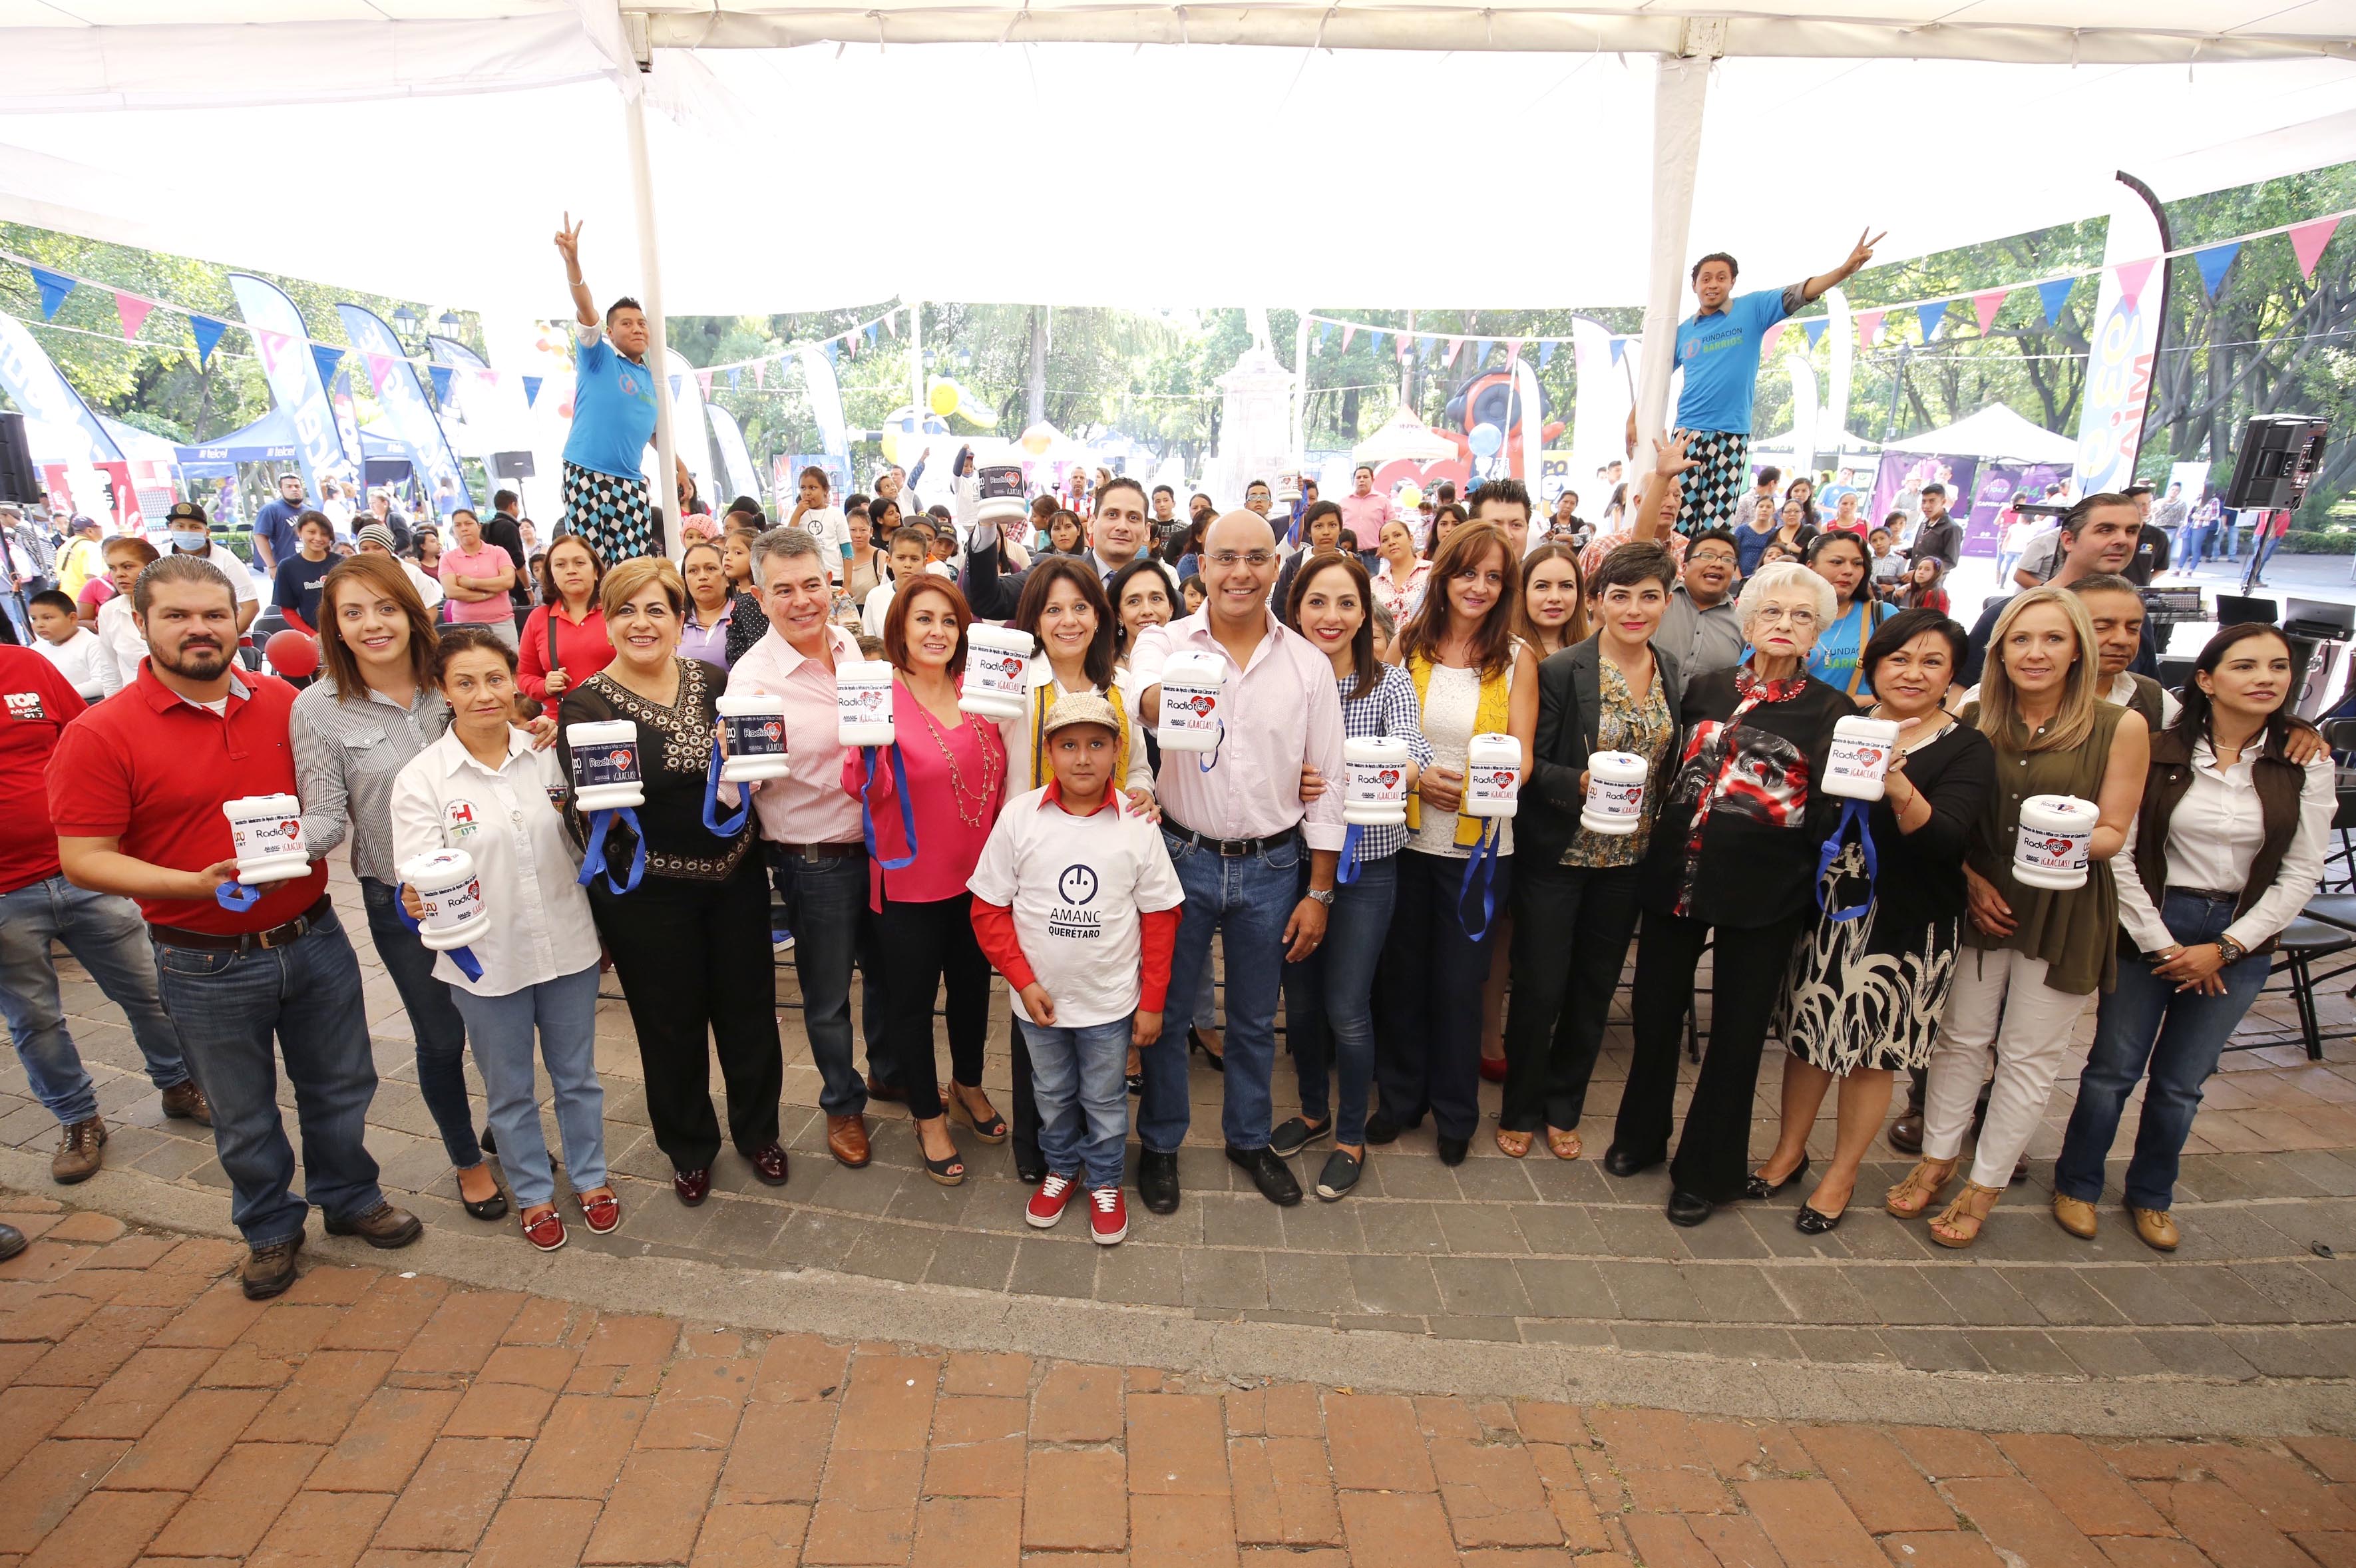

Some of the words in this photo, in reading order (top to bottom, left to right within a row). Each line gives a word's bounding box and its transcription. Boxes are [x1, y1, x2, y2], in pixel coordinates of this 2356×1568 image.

[3, 692, 40, 708] TOP
[1050, 908, 1101, 923] AMANC
[1049, 926, 1100, 938] QUERÉTARO
